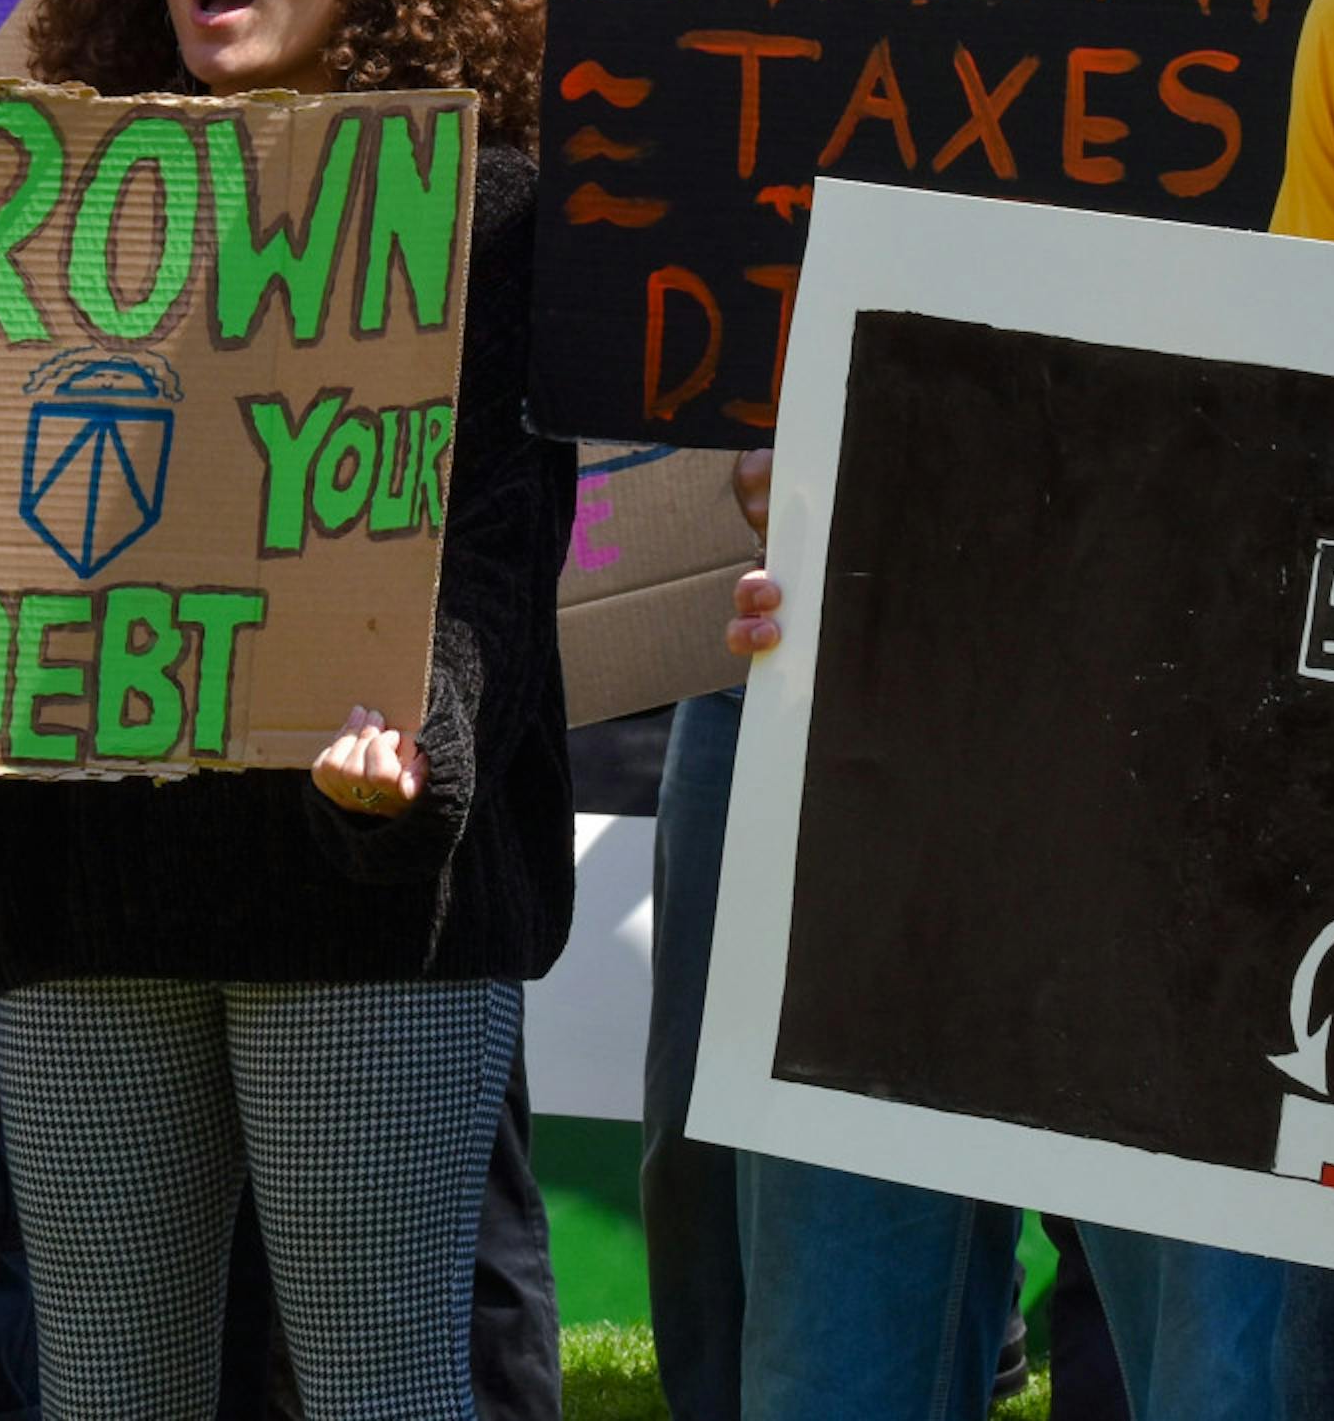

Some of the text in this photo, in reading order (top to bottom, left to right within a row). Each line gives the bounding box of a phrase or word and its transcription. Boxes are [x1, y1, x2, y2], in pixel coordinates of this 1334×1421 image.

[677, 28, 1243, 198] TAXES
[644, 263, 801, 429] DI
[239, 387, 458, 558] YOUR
